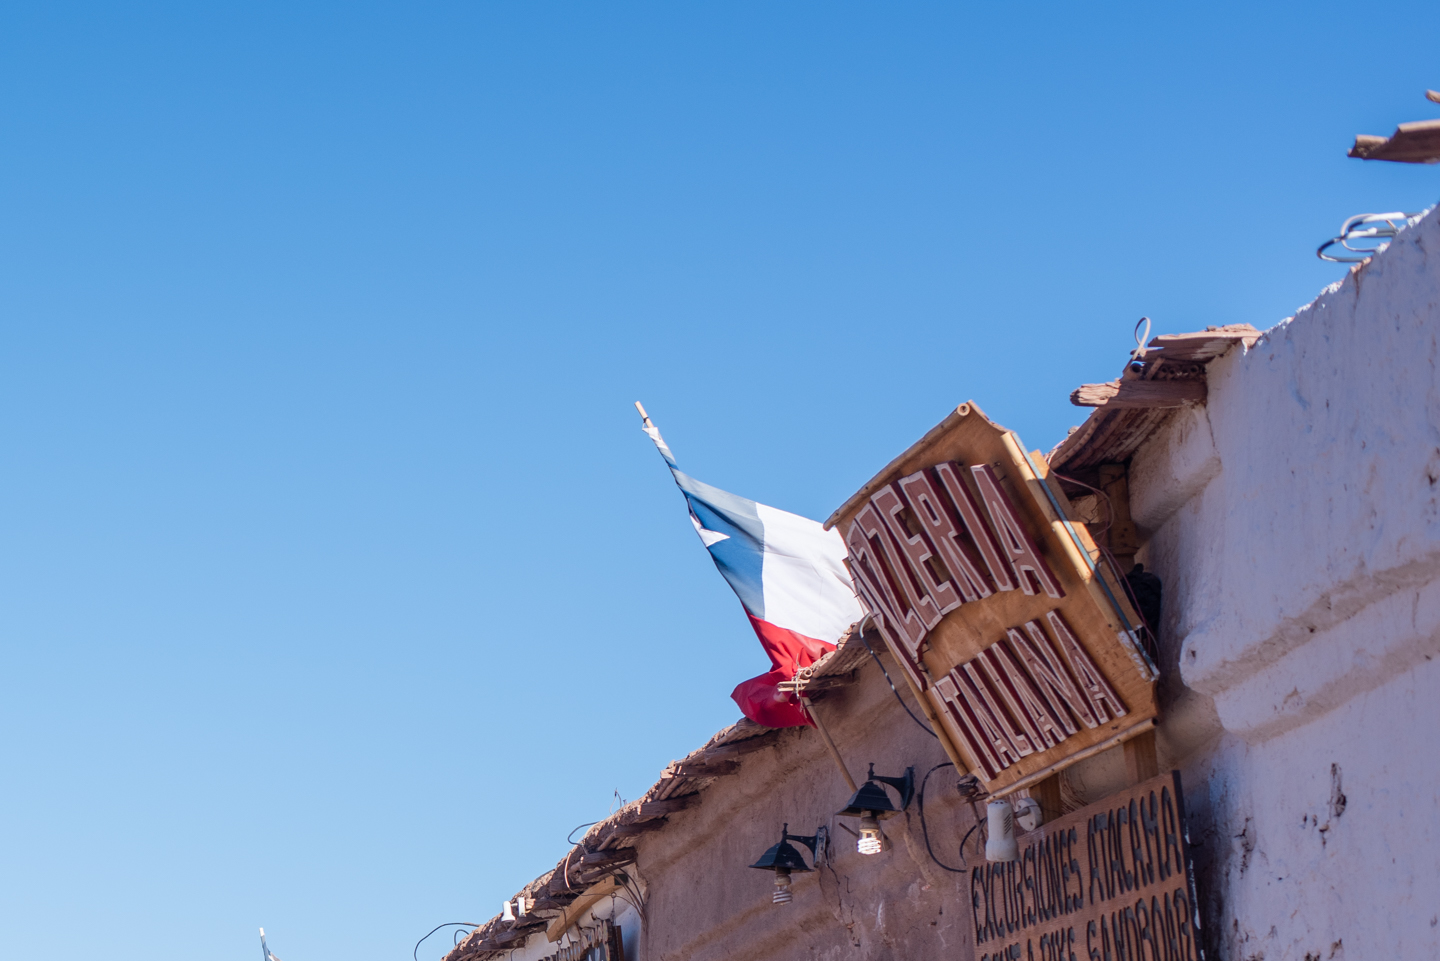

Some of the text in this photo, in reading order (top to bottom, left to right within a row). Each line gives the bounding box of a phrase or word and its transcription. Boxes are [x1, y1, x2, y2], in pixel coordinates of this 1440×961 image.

[931, 608, 1129, 782] ITALIANA
[971, 785, 1183, 946] EXCURSIONES ATACAMA
